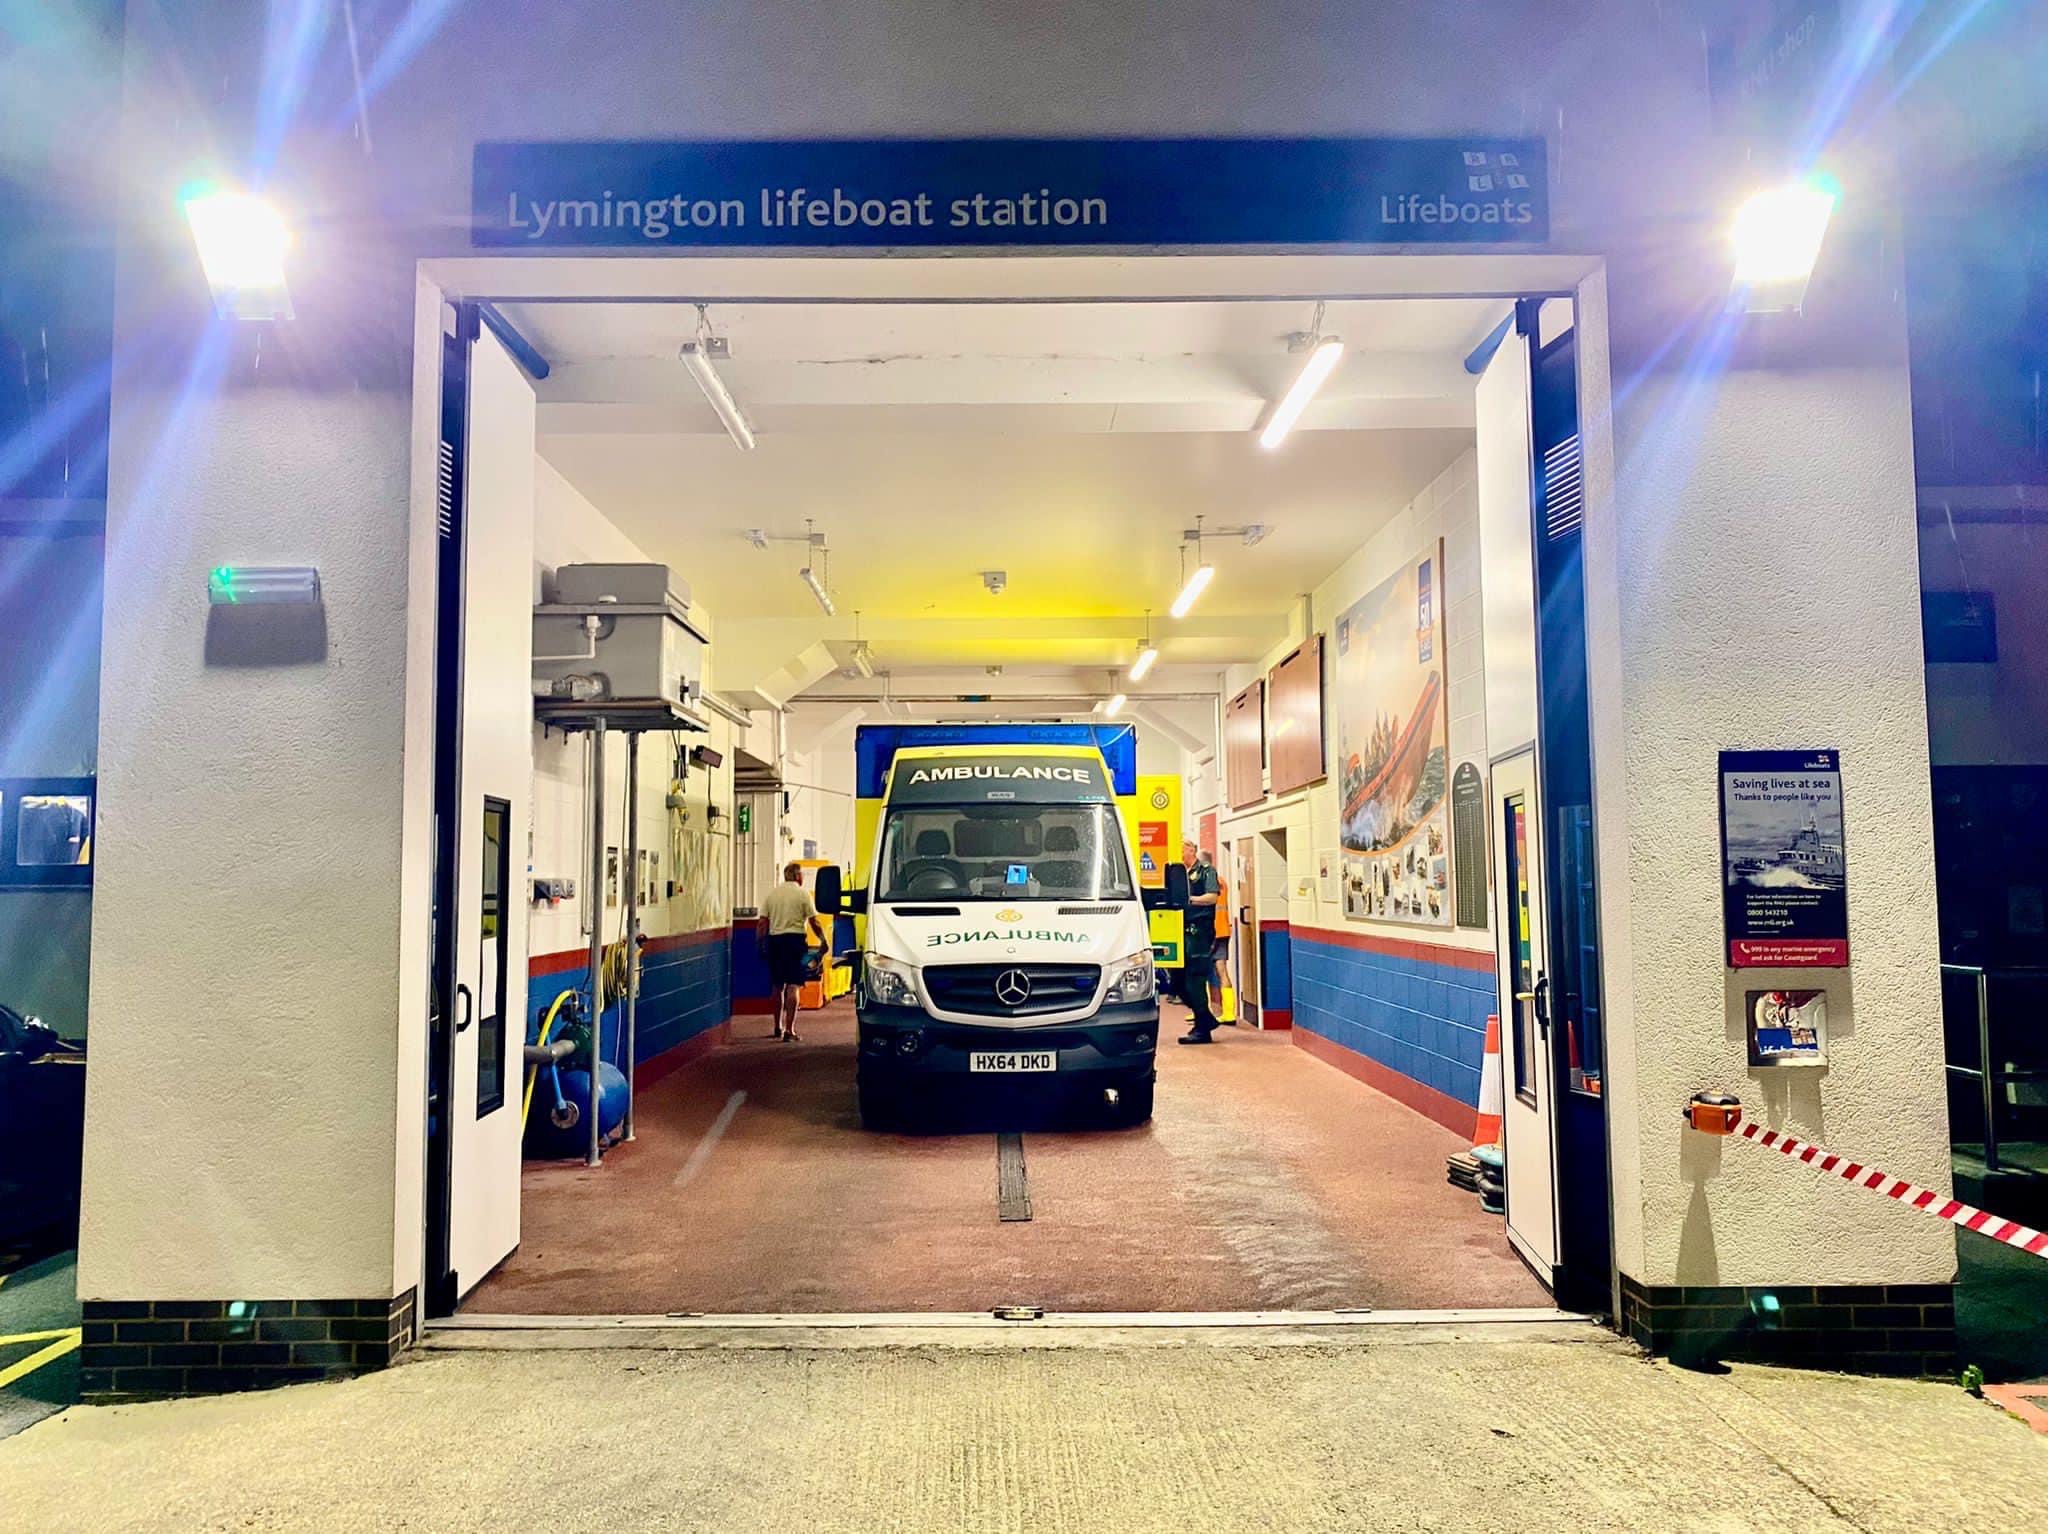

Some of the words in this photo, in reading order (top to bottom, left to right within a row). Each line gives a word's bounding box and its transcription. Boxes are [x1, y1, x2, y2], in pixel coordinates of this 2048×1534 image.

[508, 189, 745, 239] Lymington
[761, 188, 934, 227] lifeboat
[950, 188, 1107, 227] station
[1381, 194, 1533, 224] Lifeboats
[909, 766, 1091, 785] AMBULANCE
[1732, 778, 1768, 791] Saving
[1771, 778, 1796, 788] lives
[1798, 780, 1810, 788] at
[1812, 780, 1831, 788] sea
[1734, 793, 1760, 801] Thanks
[1773, 793, 1799, 802] people
[1800, 793, 1815, 801] like
[1816, 794, 1831, 802] you
[976, 1055, 1016, 1069] HX64
[1021, 1055, 1050, 1069] DKD
